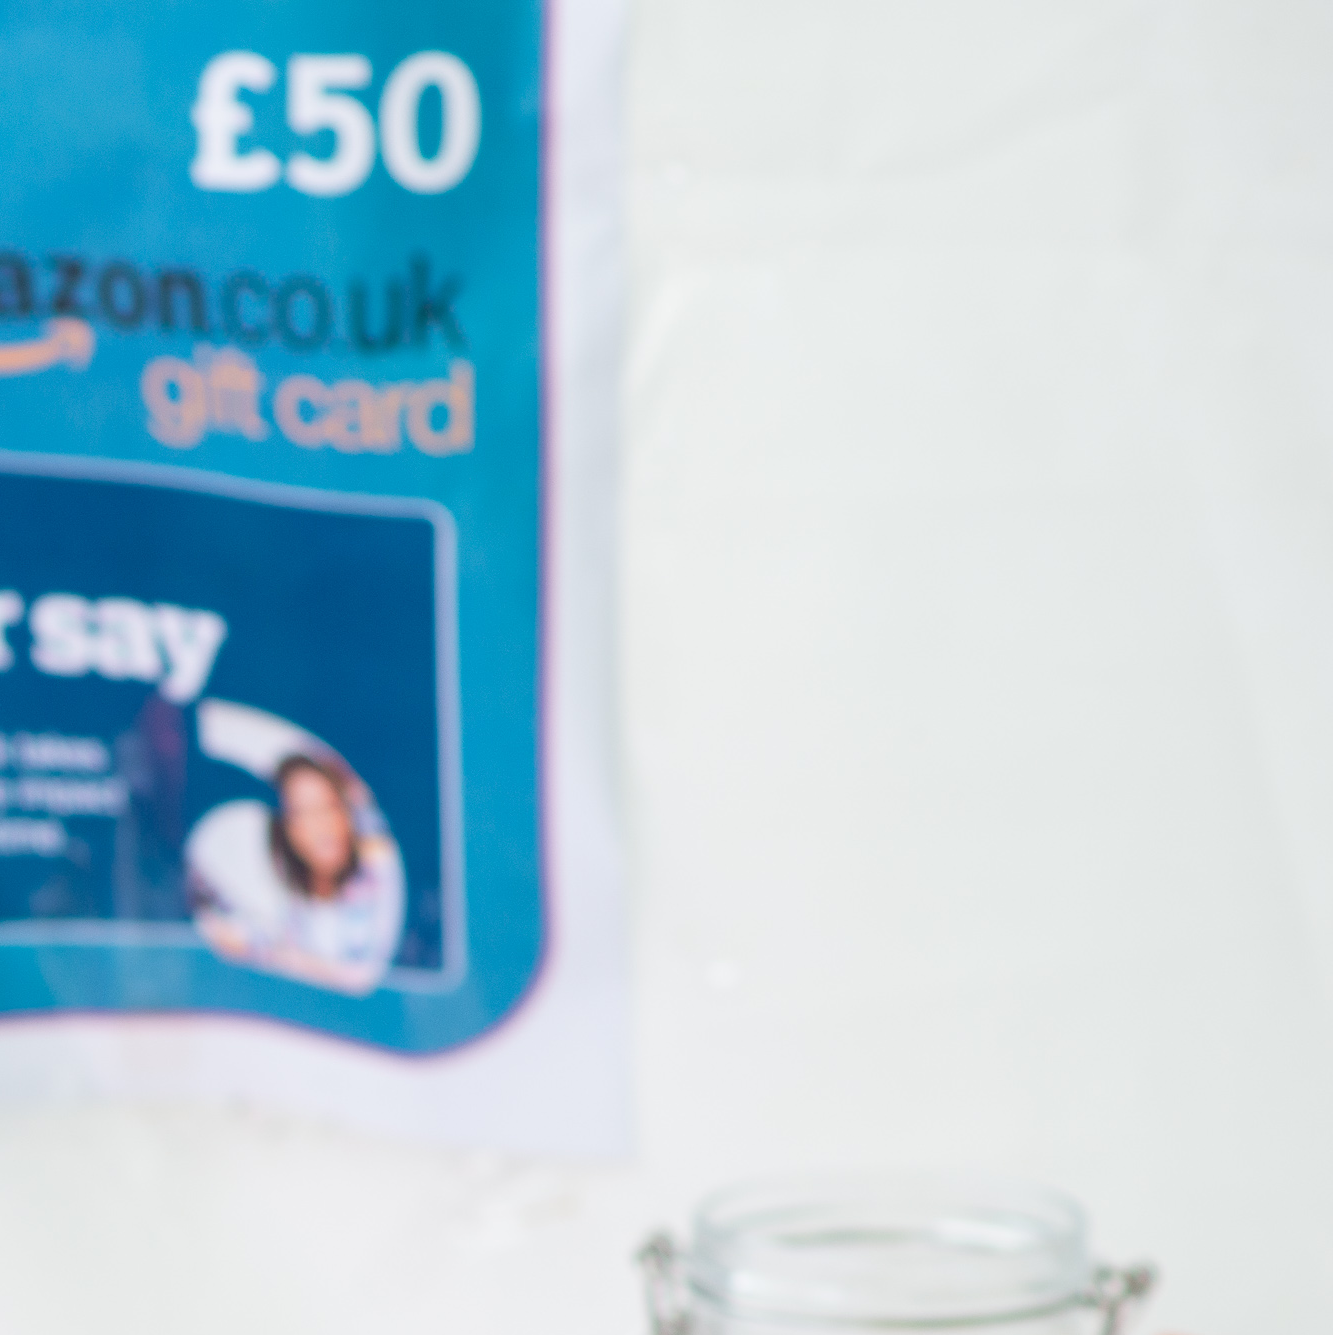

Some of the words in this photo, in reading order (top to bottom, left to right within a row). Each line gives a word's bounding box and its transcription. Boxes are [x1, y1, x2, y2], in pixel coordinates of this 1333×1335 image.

[190, 51, 481, 195] £50
[141, 345, 267, 449] gift
[275, 360, 475, 455] card
[31, 593, 225, 703] say
